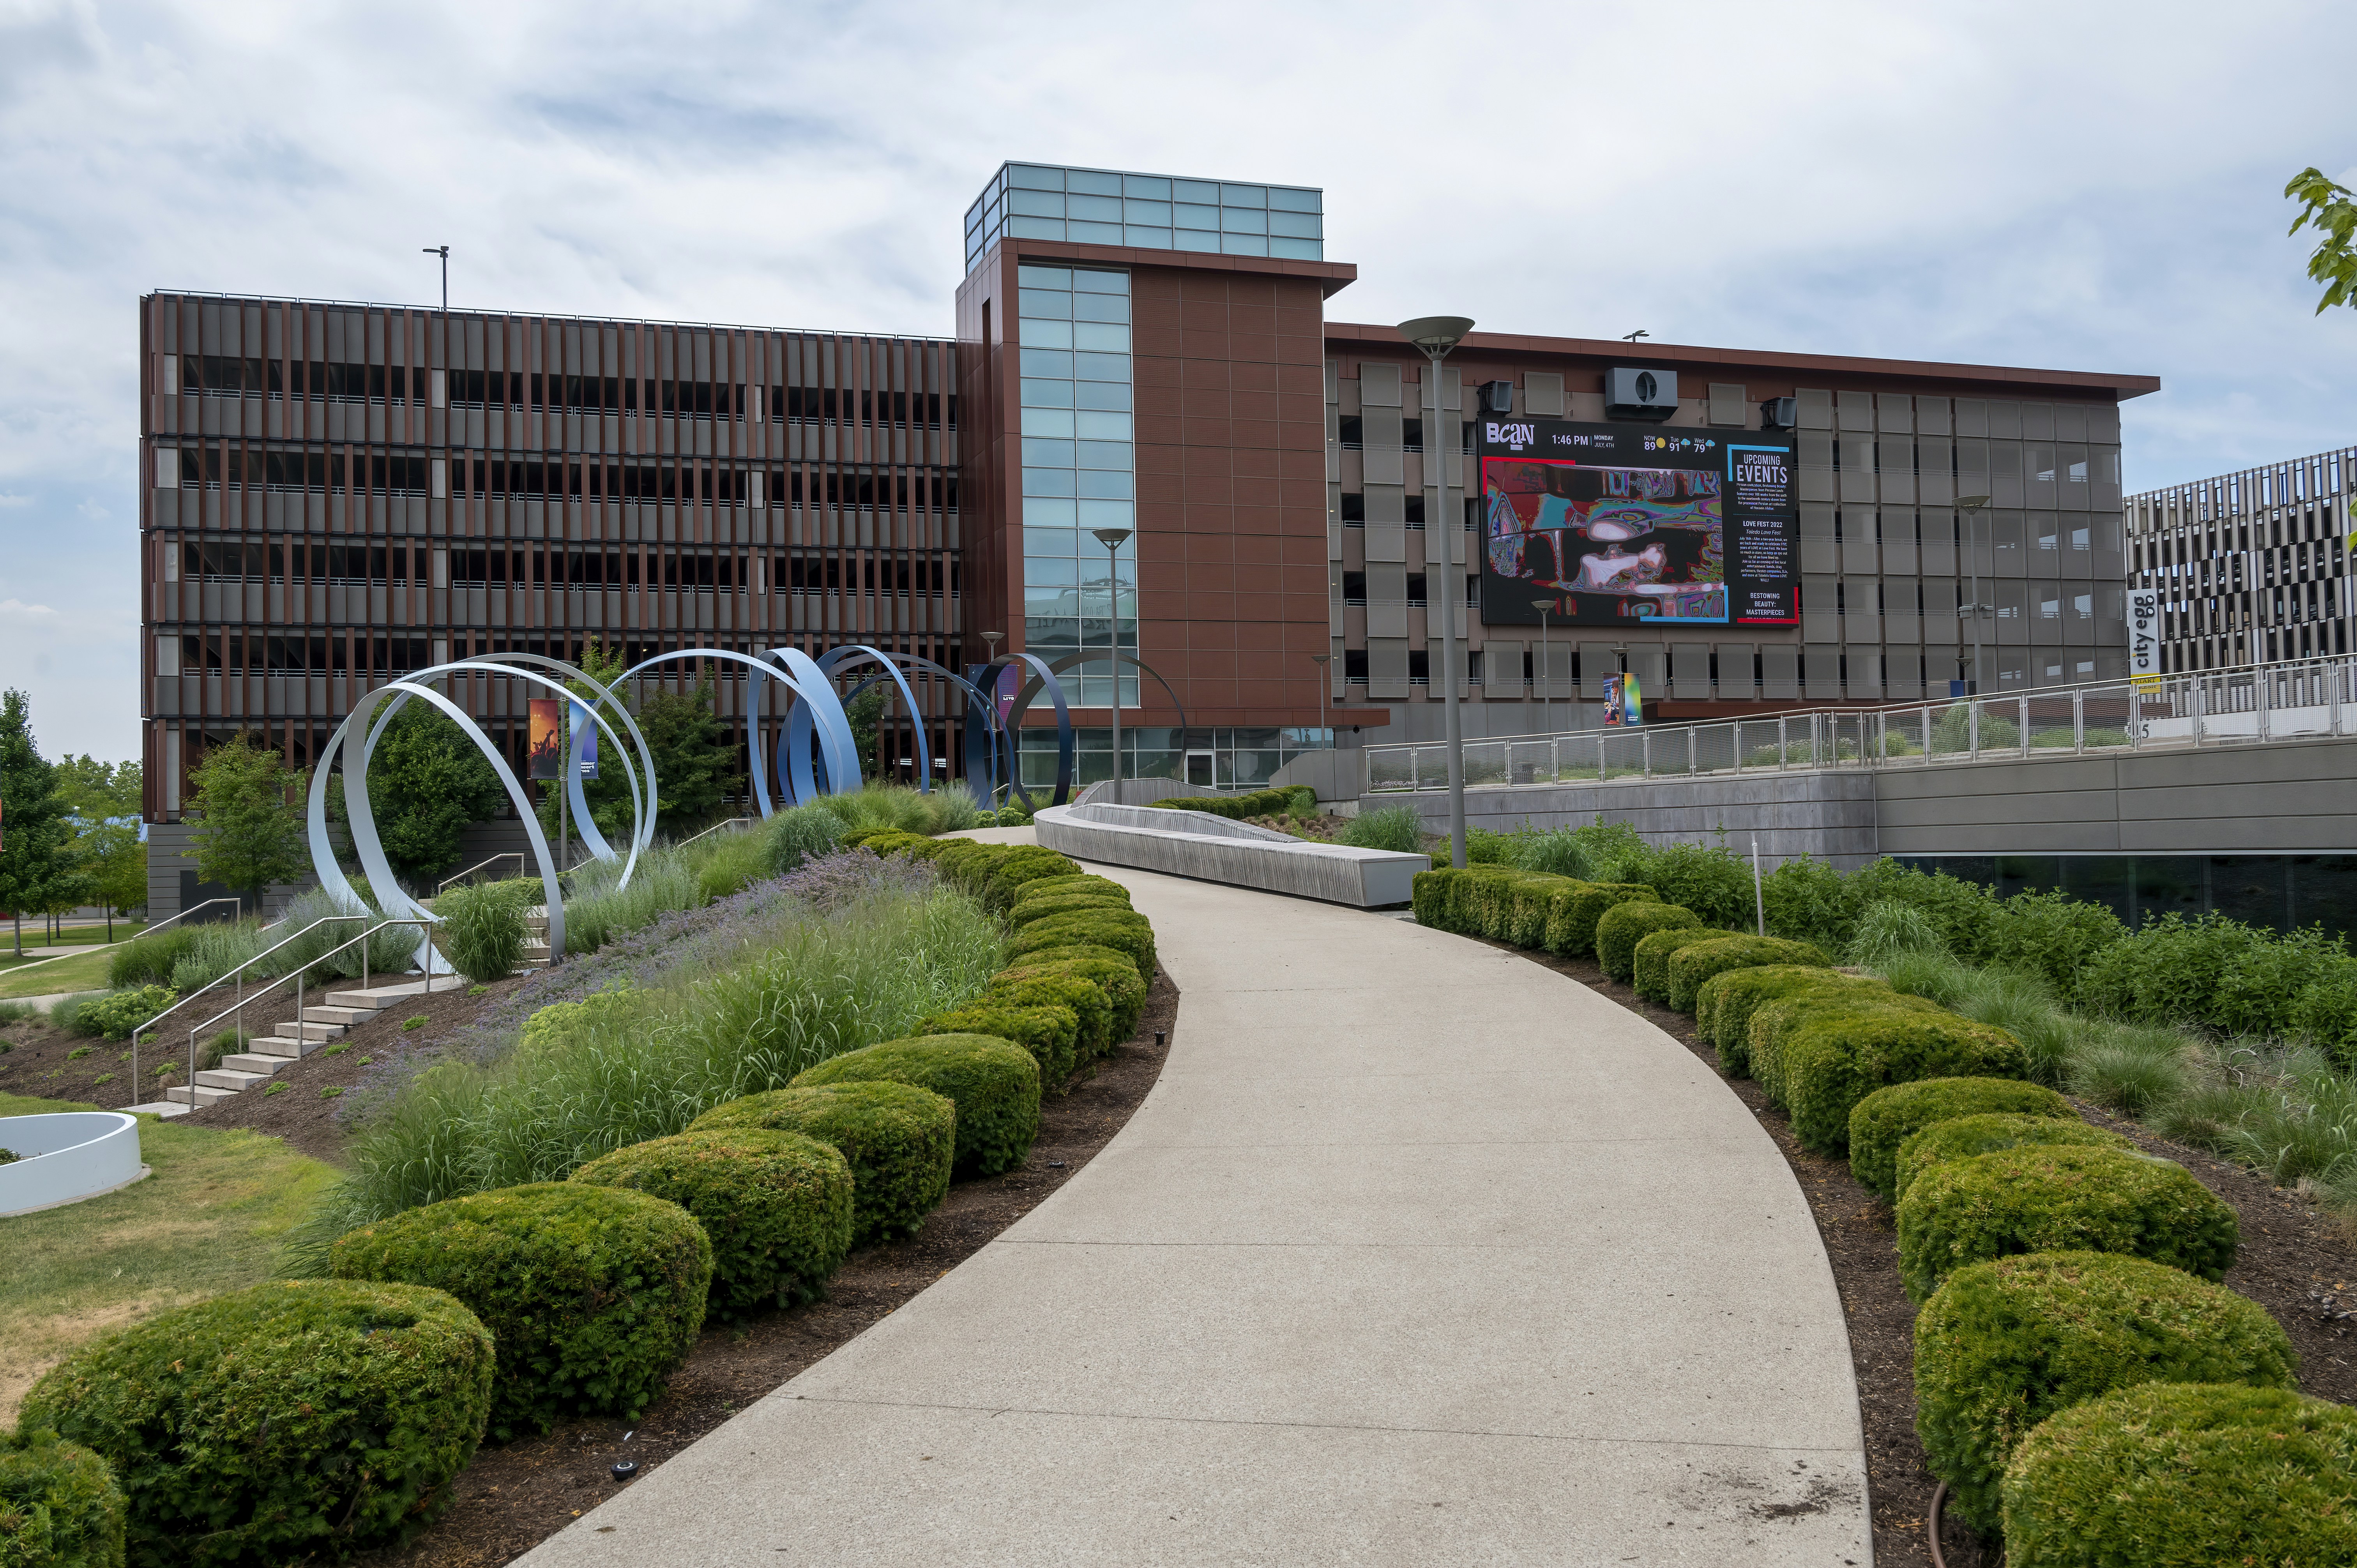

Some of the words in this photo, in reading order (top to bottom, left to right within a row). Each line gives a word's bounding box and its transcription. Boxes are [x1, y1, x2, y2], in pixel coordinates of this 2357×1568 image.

[1552, 434, 1571, 445] 1:46
[1574, 436, 1588, 445] PM
[1645, 441, 1656, 450] 89
[1670, 443, 1679, 451] 91
[1694, 444, 1705, 453] 79
[1744, 454, 1780, 465] UPCOMING
[1737, 465, 1787, 483] EVENTS
[2134, 595, 2155, 629] egg
[2132, 633, 2155, 667] city
